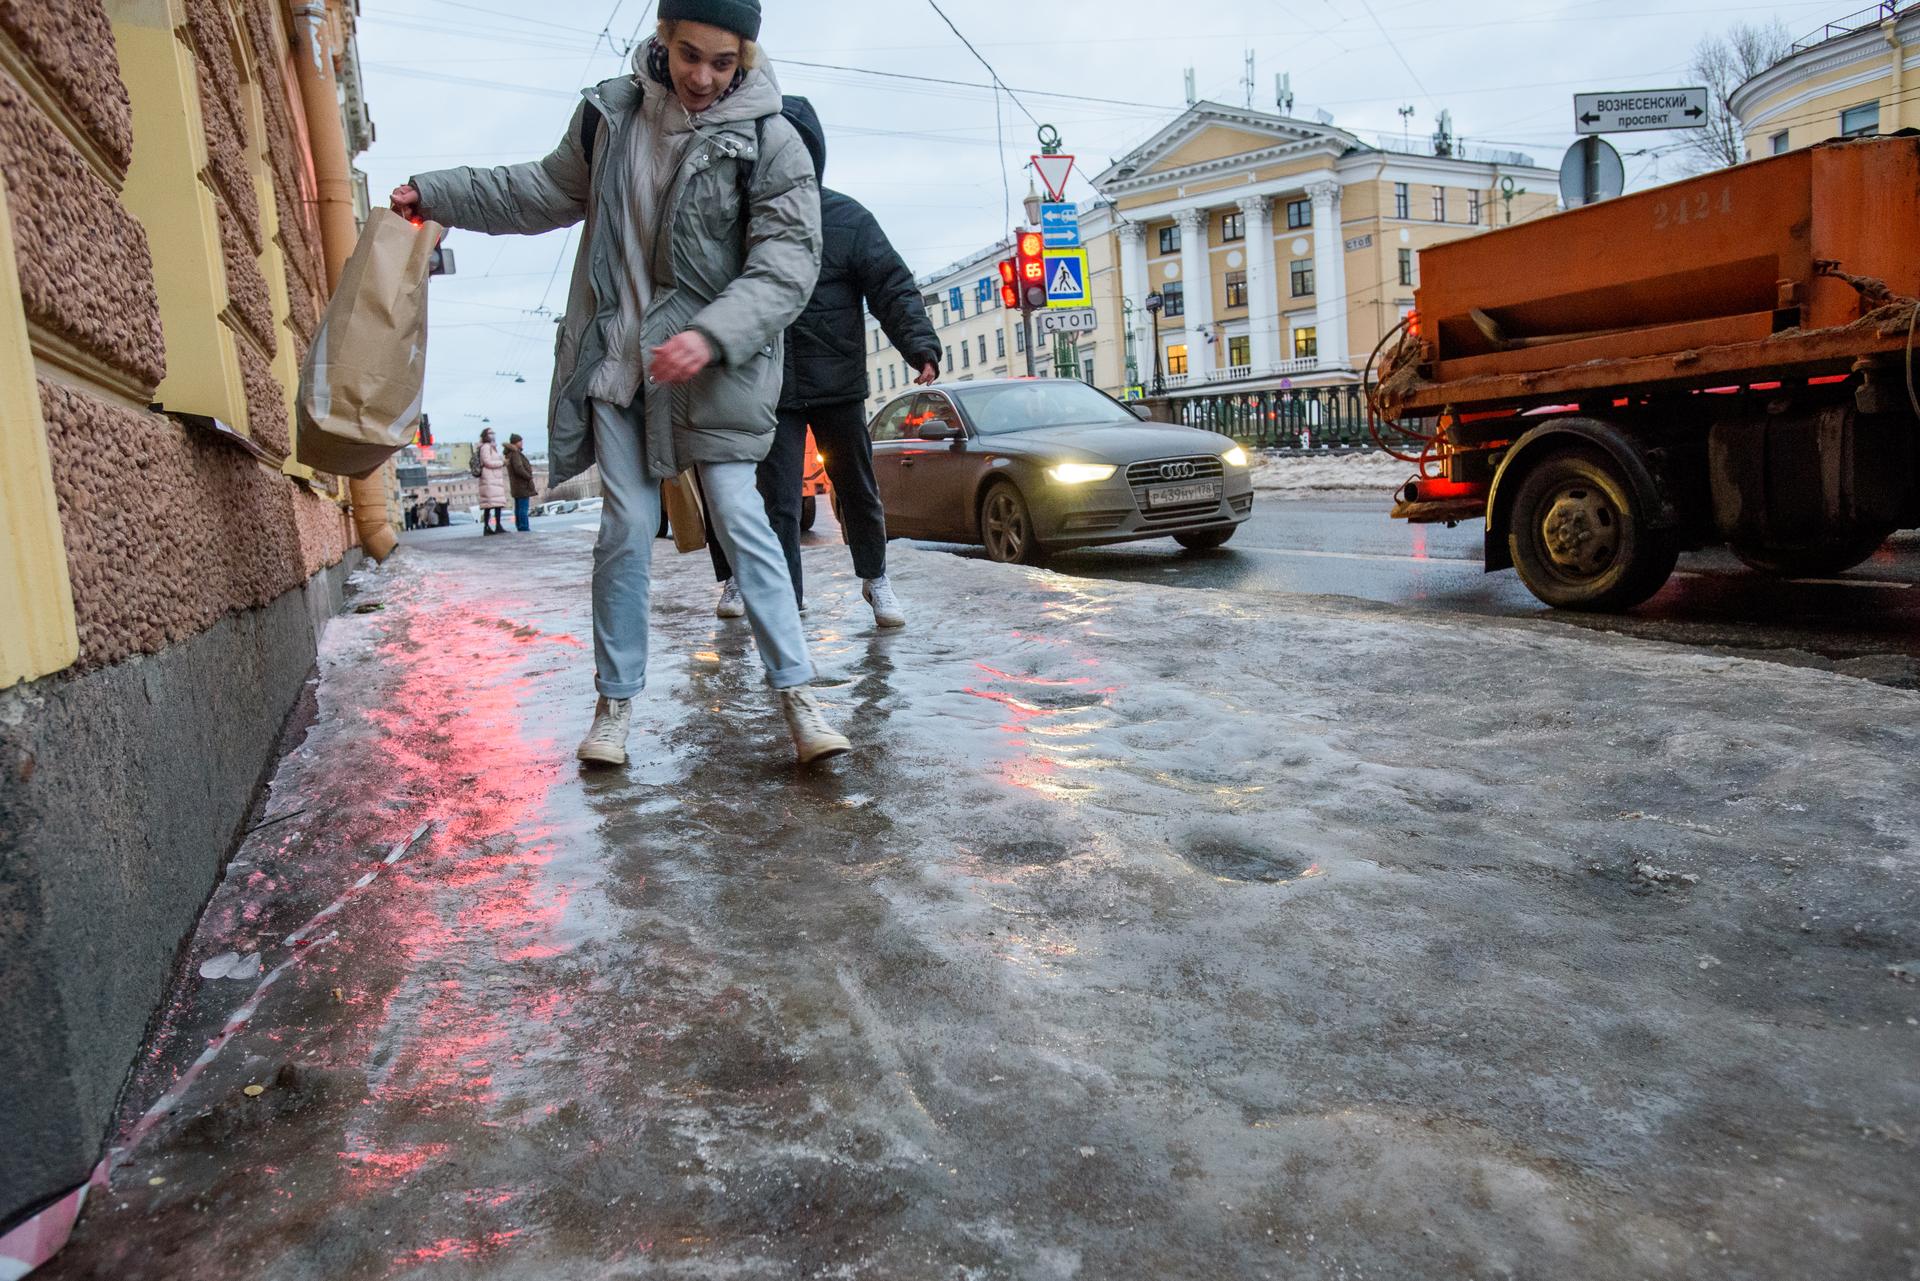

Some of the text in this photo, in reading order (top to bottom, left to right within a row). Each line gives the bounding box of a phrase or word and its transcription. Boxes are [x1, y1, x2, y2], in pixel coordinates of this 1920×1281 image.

[1597, 94, 1687, 112] ВОЗНЕСЕНСКИЙ
[1618, 114, 1668, 128] проспект
[1045, 313, 1093, 329] СТОП
